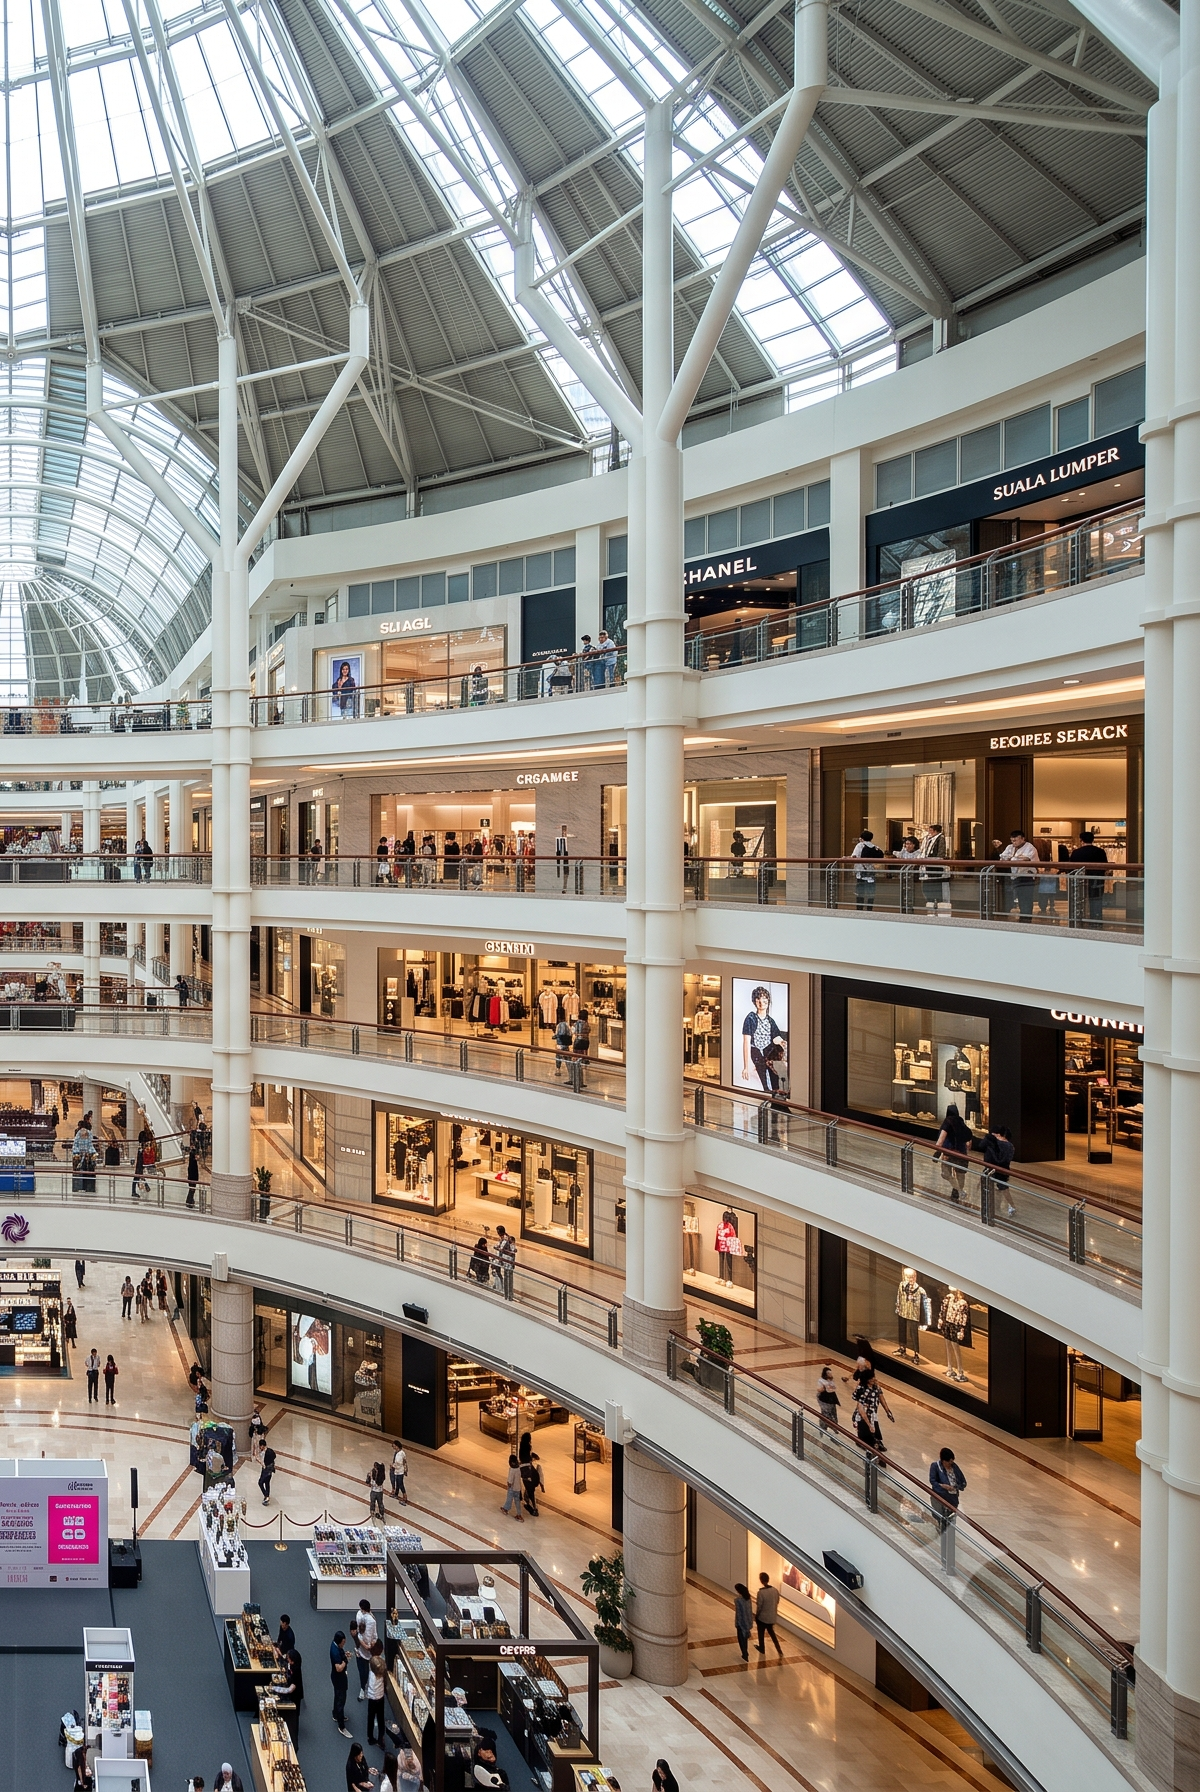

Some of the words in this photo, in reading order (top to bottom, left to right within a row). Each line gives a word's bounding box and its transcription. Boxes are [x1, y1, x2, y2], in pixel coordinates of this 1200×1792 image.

[993, 473, 1046, 501] SUALA
[1050, 447, 1120, 483] LUMPER
[684, 557, 757, 585] HANEL
